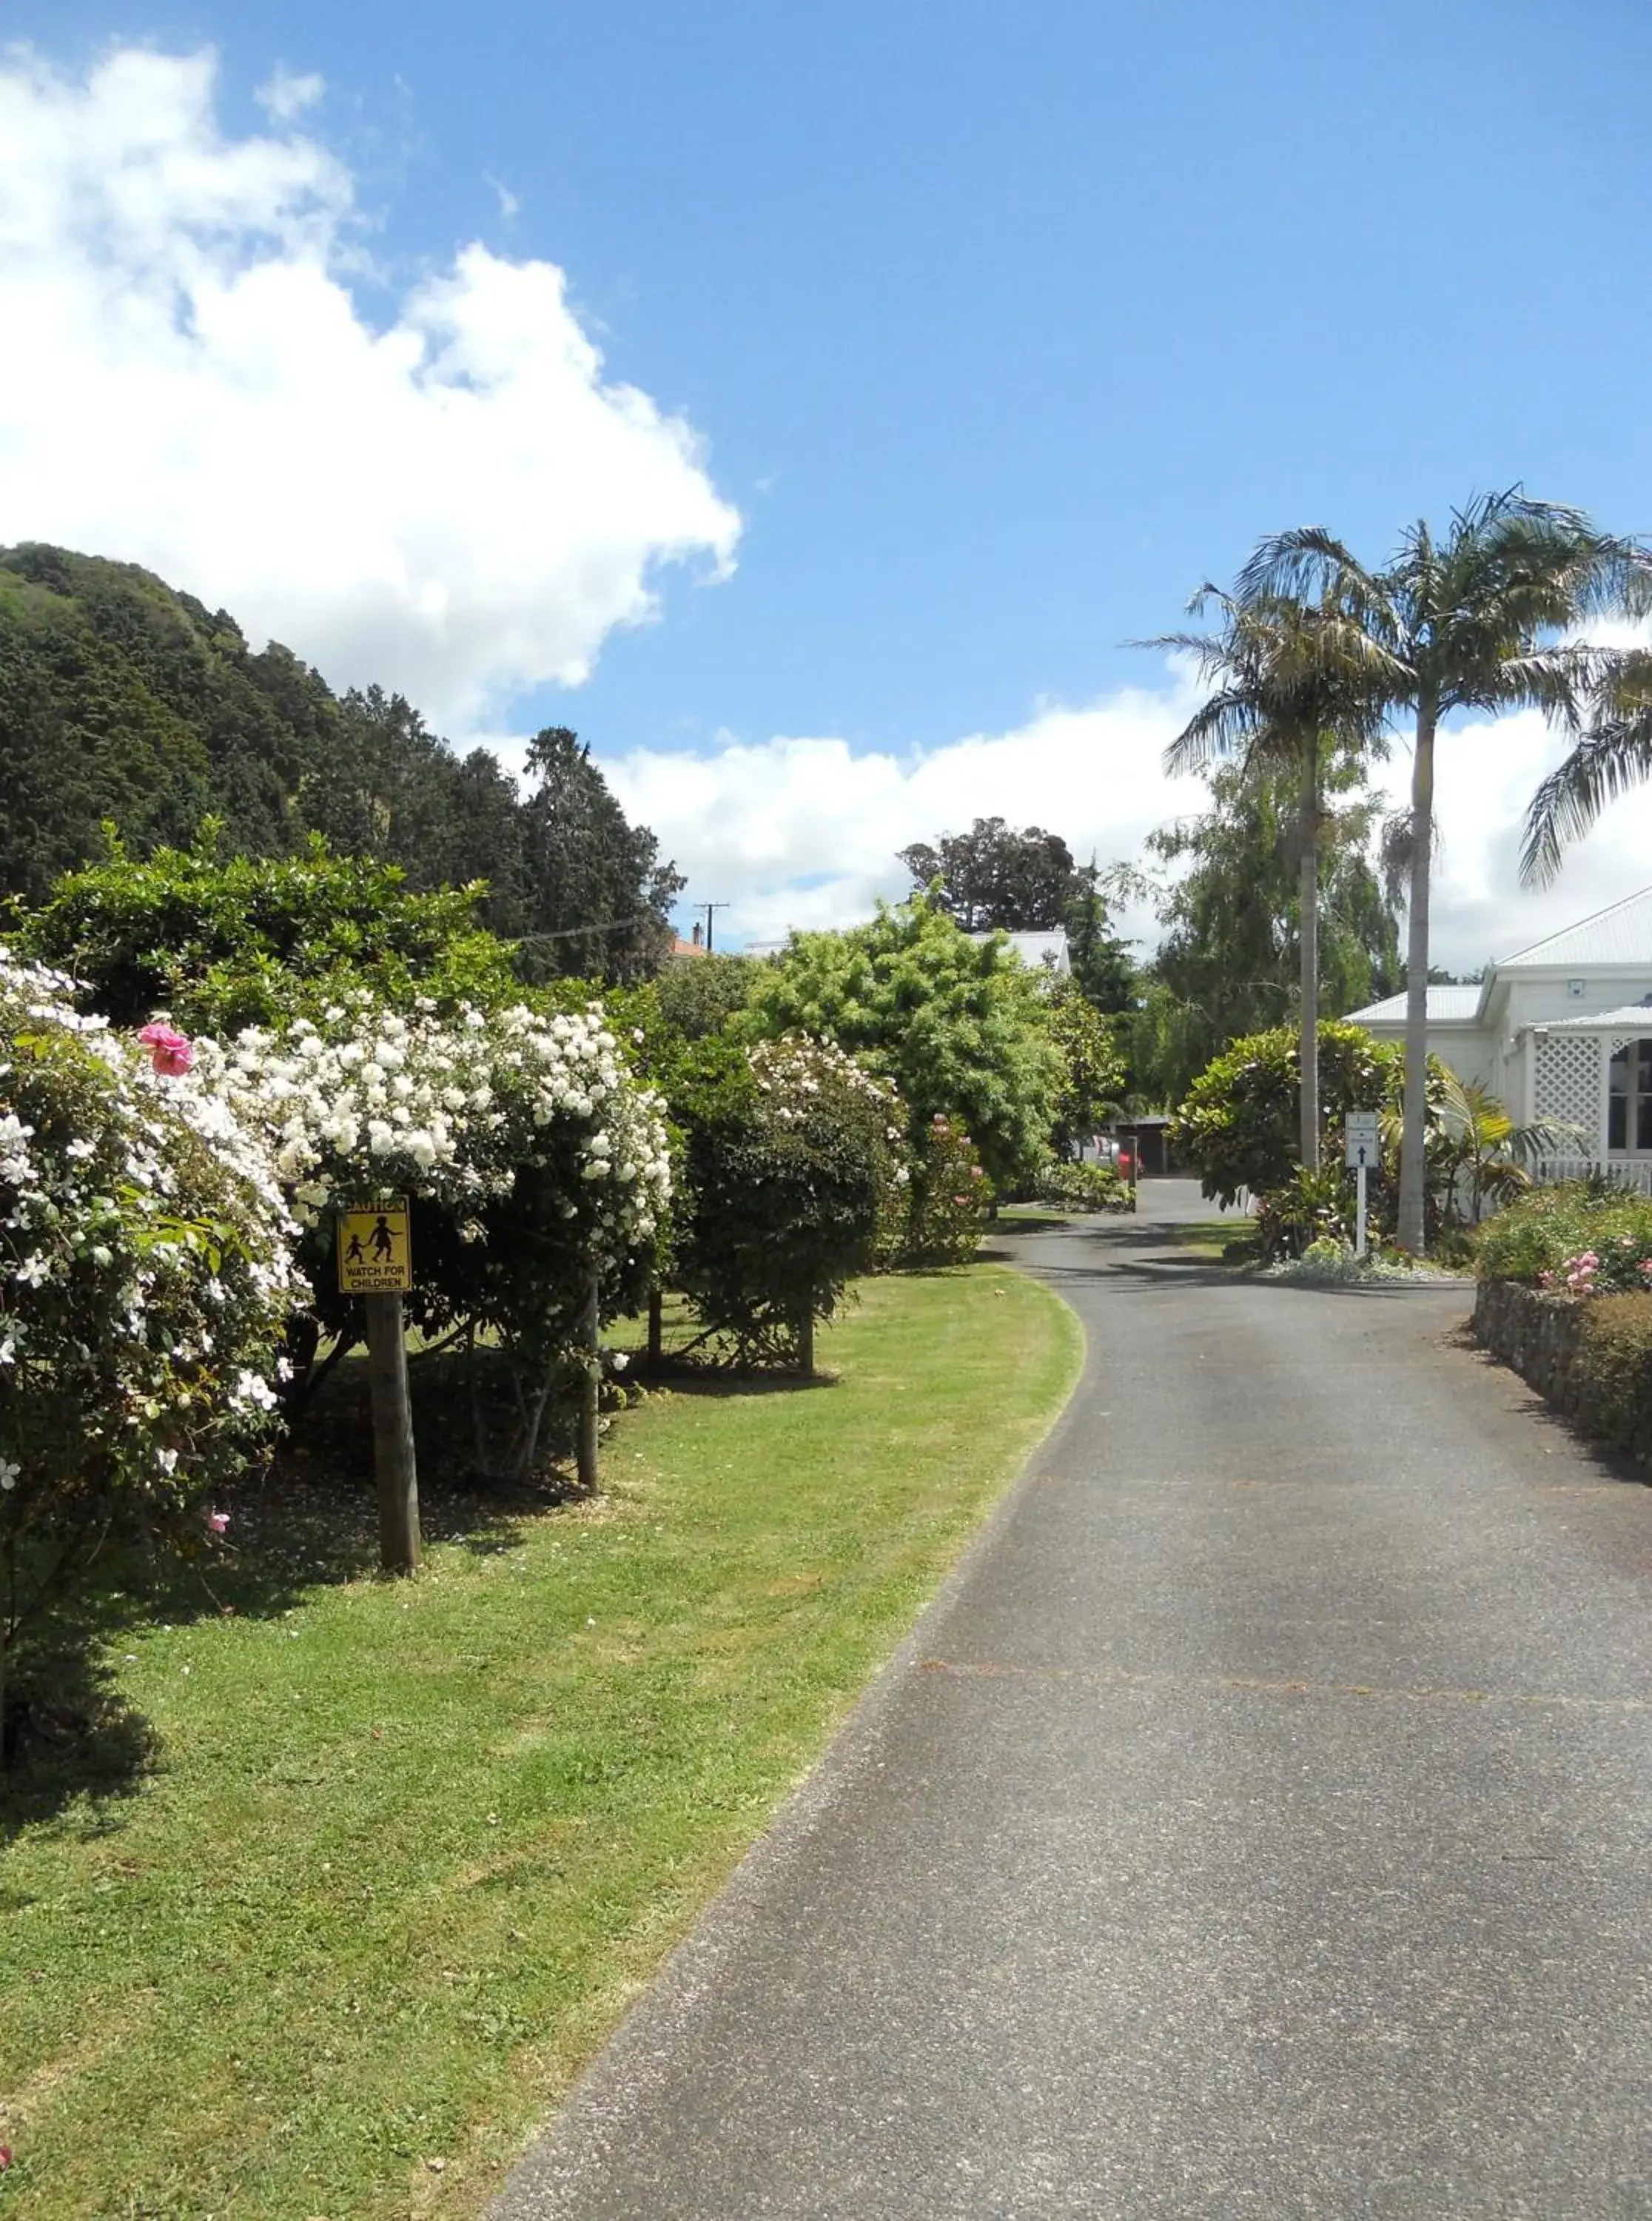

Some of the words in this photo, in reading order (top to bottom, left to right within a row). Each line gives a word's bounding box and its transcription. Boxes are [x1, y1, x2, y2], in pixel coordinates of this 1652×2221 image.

[346, 1267, 380, 1276] WATCH
[384, 1265, 405, 1276] FOR
[351, 1278, 401, 1287] CHILDREN
